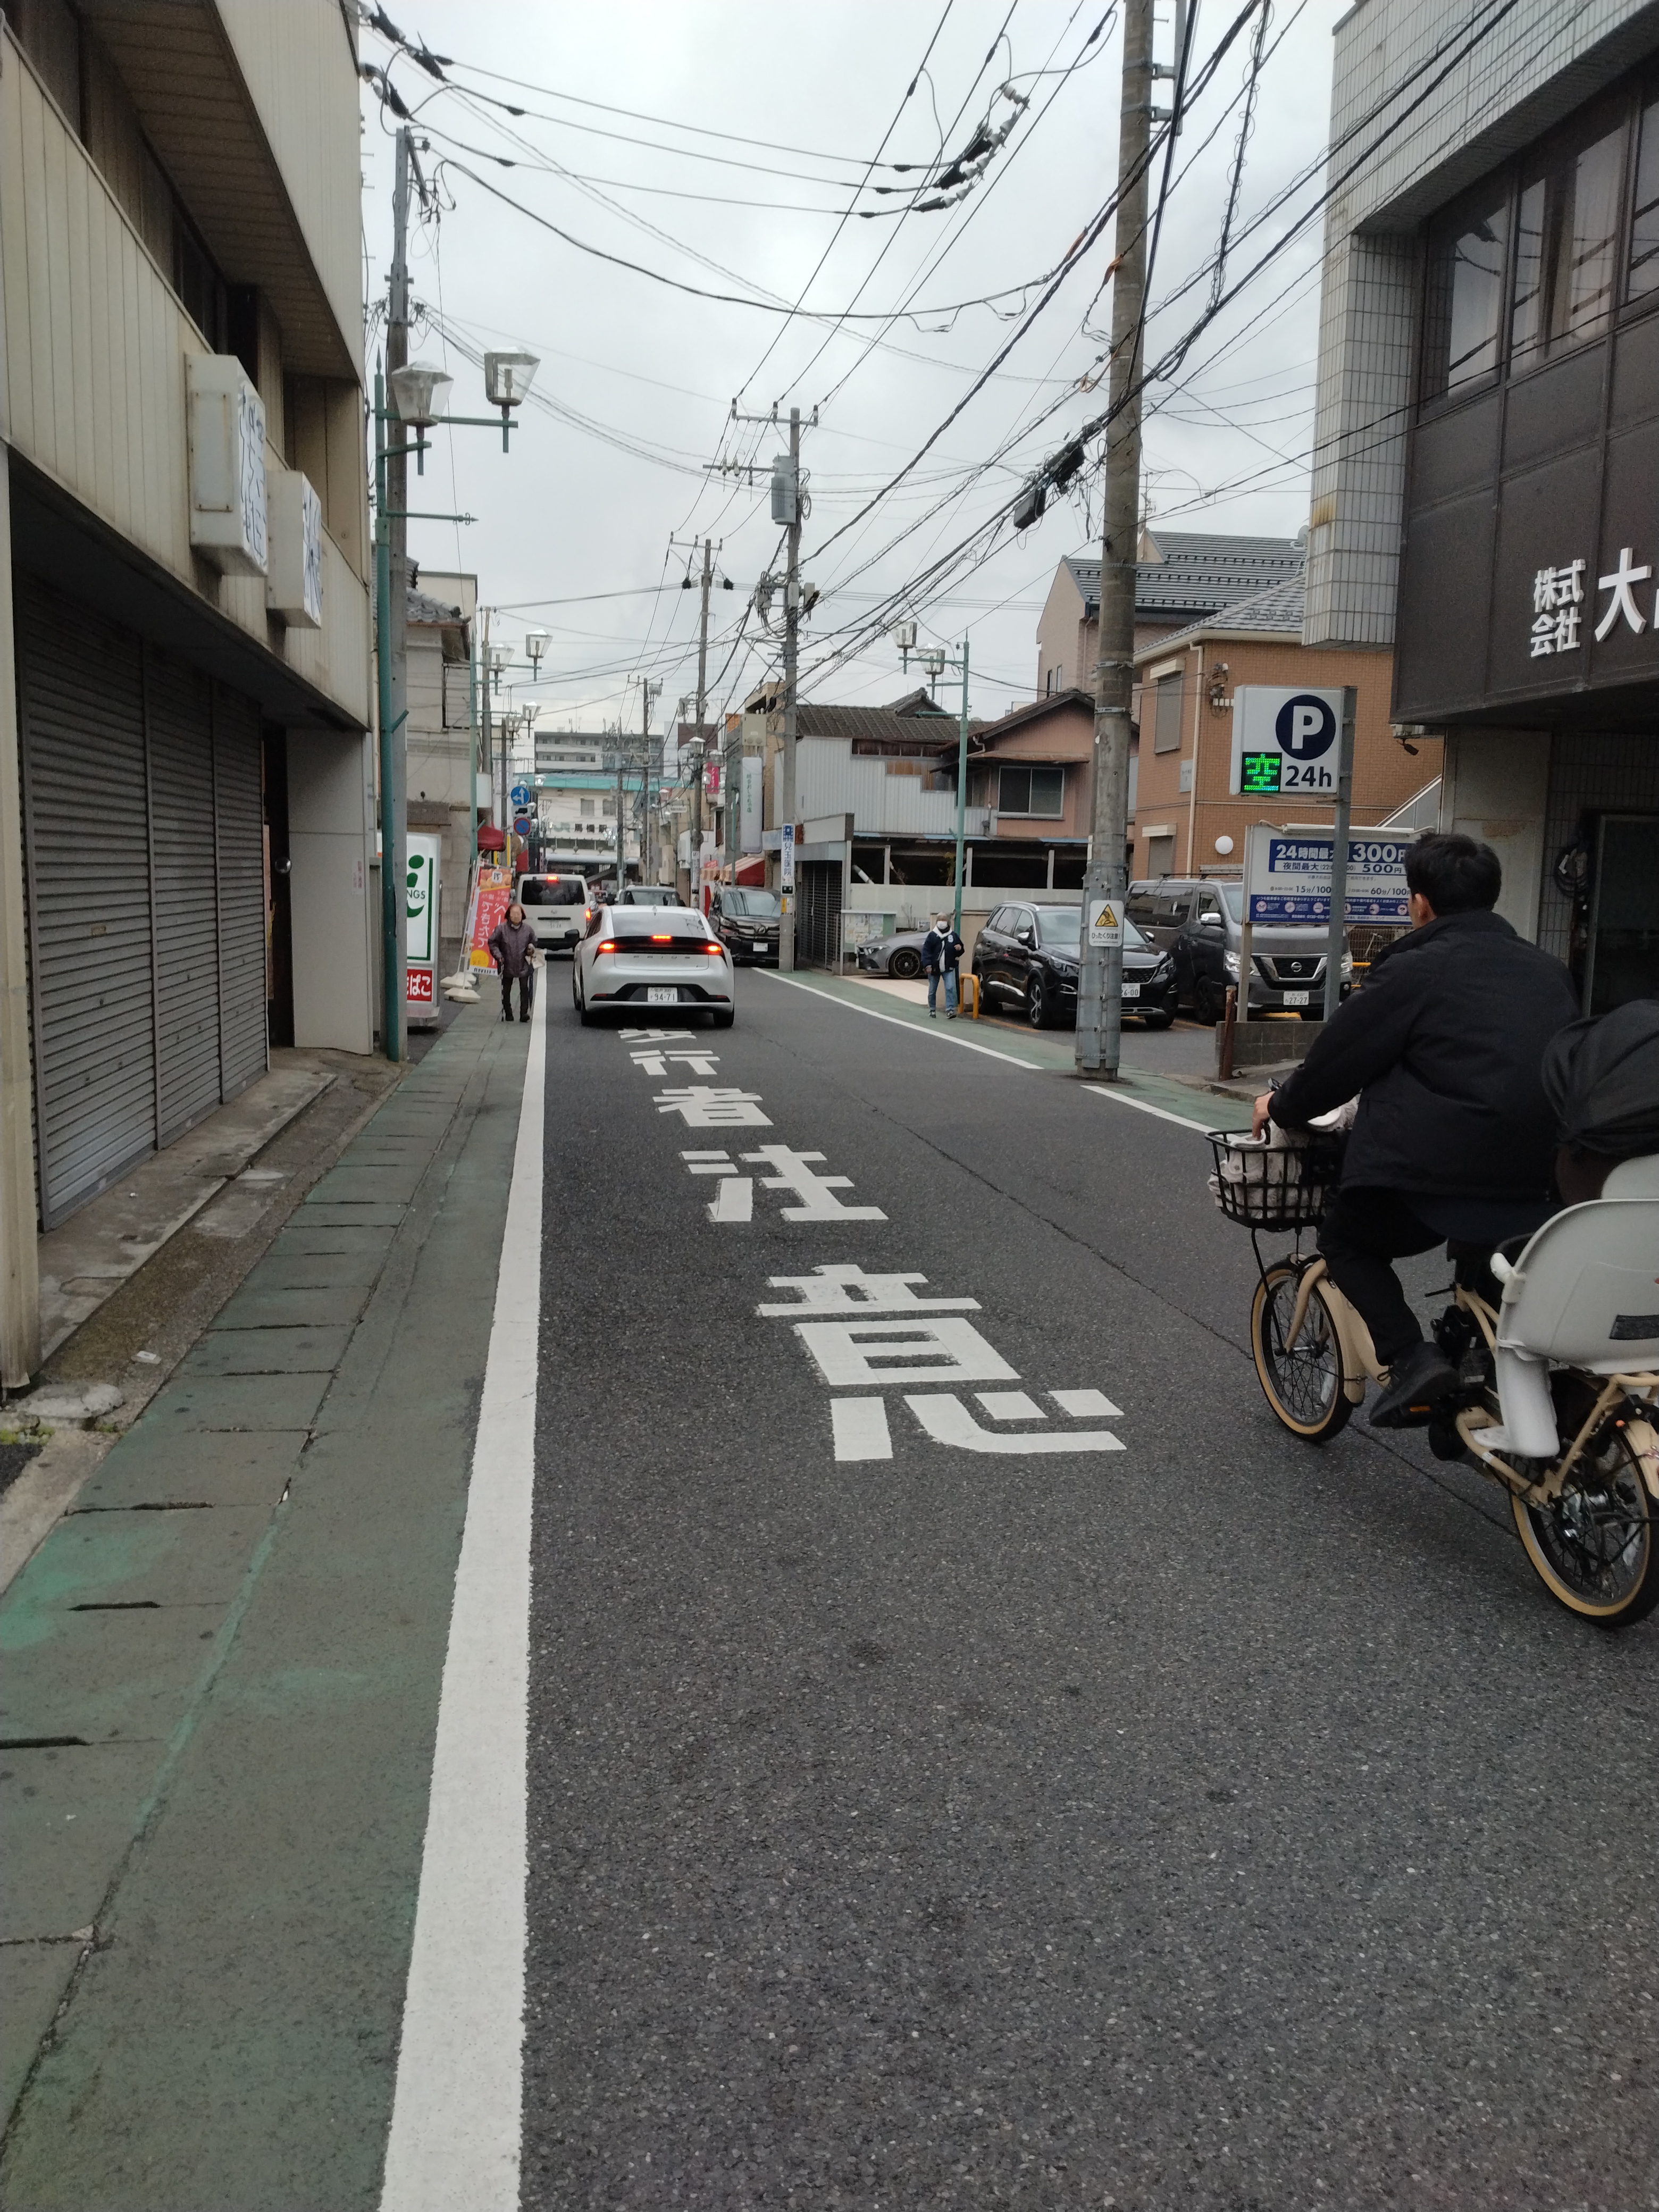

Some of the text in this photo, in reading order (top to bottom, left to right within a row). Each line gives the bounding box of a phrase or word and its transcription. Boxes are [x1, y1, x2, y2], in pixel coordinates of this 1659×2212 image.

[1534, 559, 1586, 613] 株式
[1595, 547, 1659, 642] 大
[1530, 607, 1581, 658] 会社
[1292, 705, 1323, 749] P
[1244, 753, 1280, 791] 空
[1285, 765, 1332, 787] 24h
[1362, 864, 1402, 874] 500円
[407, 974, 431, 996] ばこ
[655, 993, 675, 1001] 94-71
